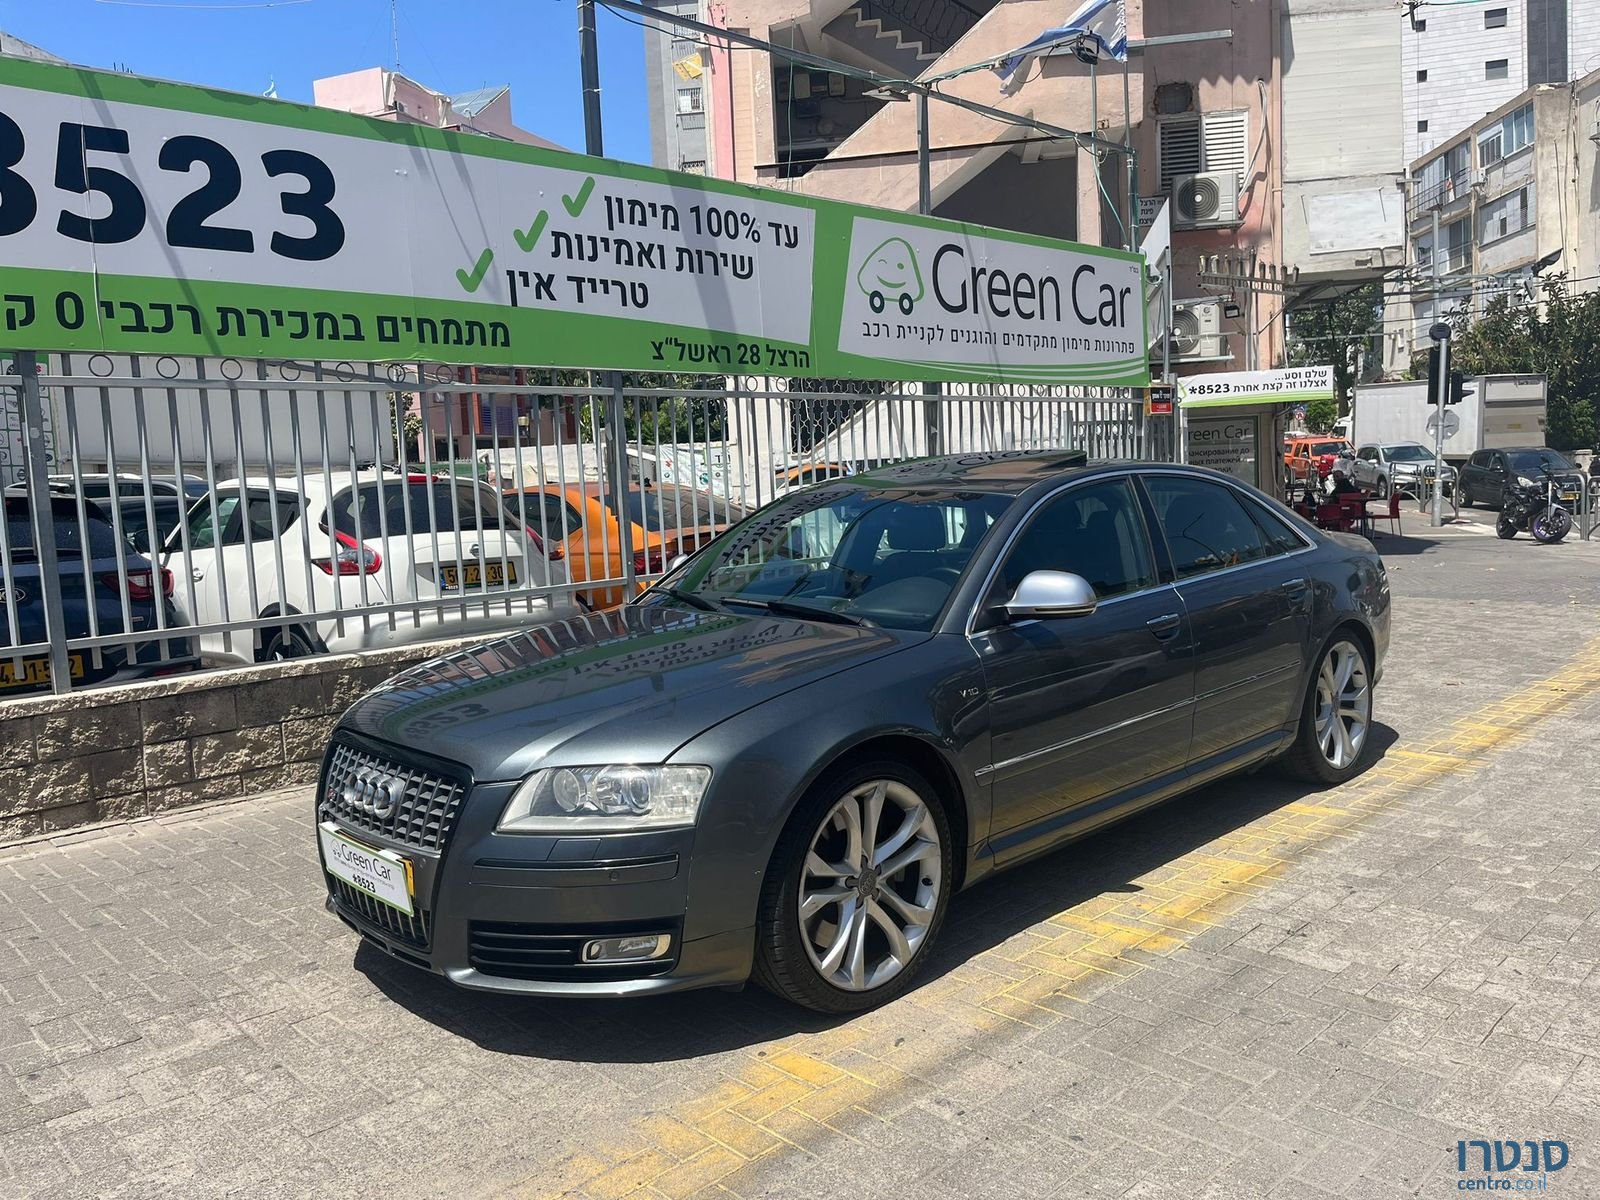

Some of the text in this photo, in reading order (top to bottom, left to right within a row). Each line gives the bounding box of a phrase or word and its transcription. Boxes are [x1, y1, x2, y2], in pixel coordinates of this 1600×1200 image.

[604, 195, 799, 249] עד 100% מימון
[550, 229, 754, 280] שירות ואמינות
[506, 269, 649, 309] טרייד אין
[932, 243, 1131, 328] Green Car
[55, 291, 84, 330] 0
[100, 300, 201, 335] רכבי
[216, 306, 365, 341] במכירת
[376, 315, 511, 348] מתמחים
[862, 321, 1135, 354] פתרונות מימון מתקדמים והוגנים לקניית רכב
[737, 342, 761, 366] 28
[766, 342, 810, 369] הרצל
[1233, 383, 1259, 393] אחרת
[1262, 381, 1283, 392] קצת
[1286, 380, 1296, 389] זה
[1300, 379, 1327, 388] אצלנו
[1305, 370, 1327, 378] שלם
[1188, 424, 1249, 441] reen Car
[1240, 447, 1250, 455] до
[341, 843, 373, 872] Green
[372, 858, 391, 881] Car
